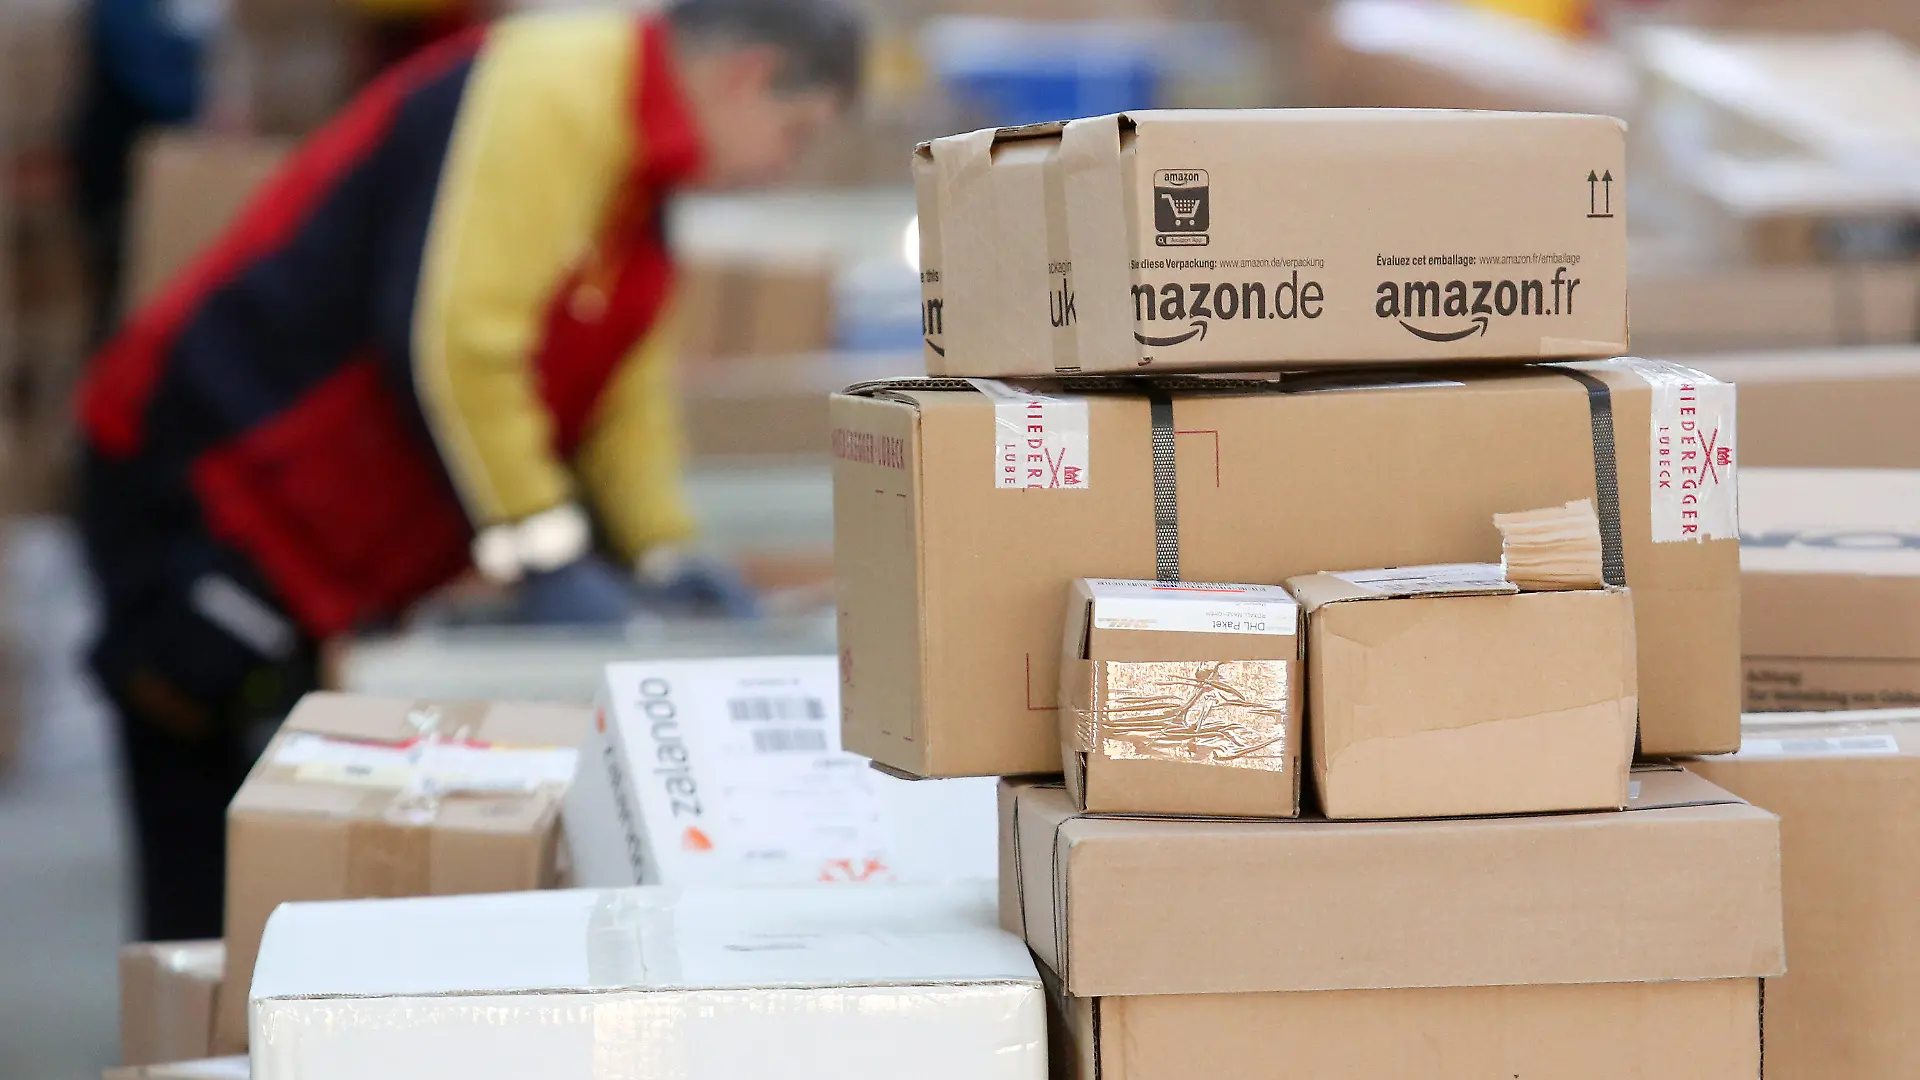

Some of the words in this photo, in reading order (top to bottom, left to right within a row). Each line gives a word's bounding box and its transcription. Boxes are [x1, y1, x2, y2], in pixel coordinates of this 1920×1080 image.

[1164, 173, 1199, 182] amazon
[1140, 258, 1165, 269] diese
[1165, 258, 1217, 271] Verpackung:
[1219, 257, 1325, 269] www.amazon.de/verpackung
[1376, 253, 1410, 266] Évaluez
[1412, 255, 1427, 266] cet
[1428, 254, 1476, 267] emballage:
[1480, 253, 1581, 266] www.amazon.fr/emballage
[1375, 266, 1581, 318] amazon.fr
[1212, 620, 1241, 630] Paket
[1243, 621, 1265, 631] DHL
[634, 677, 703, 818] zalando
